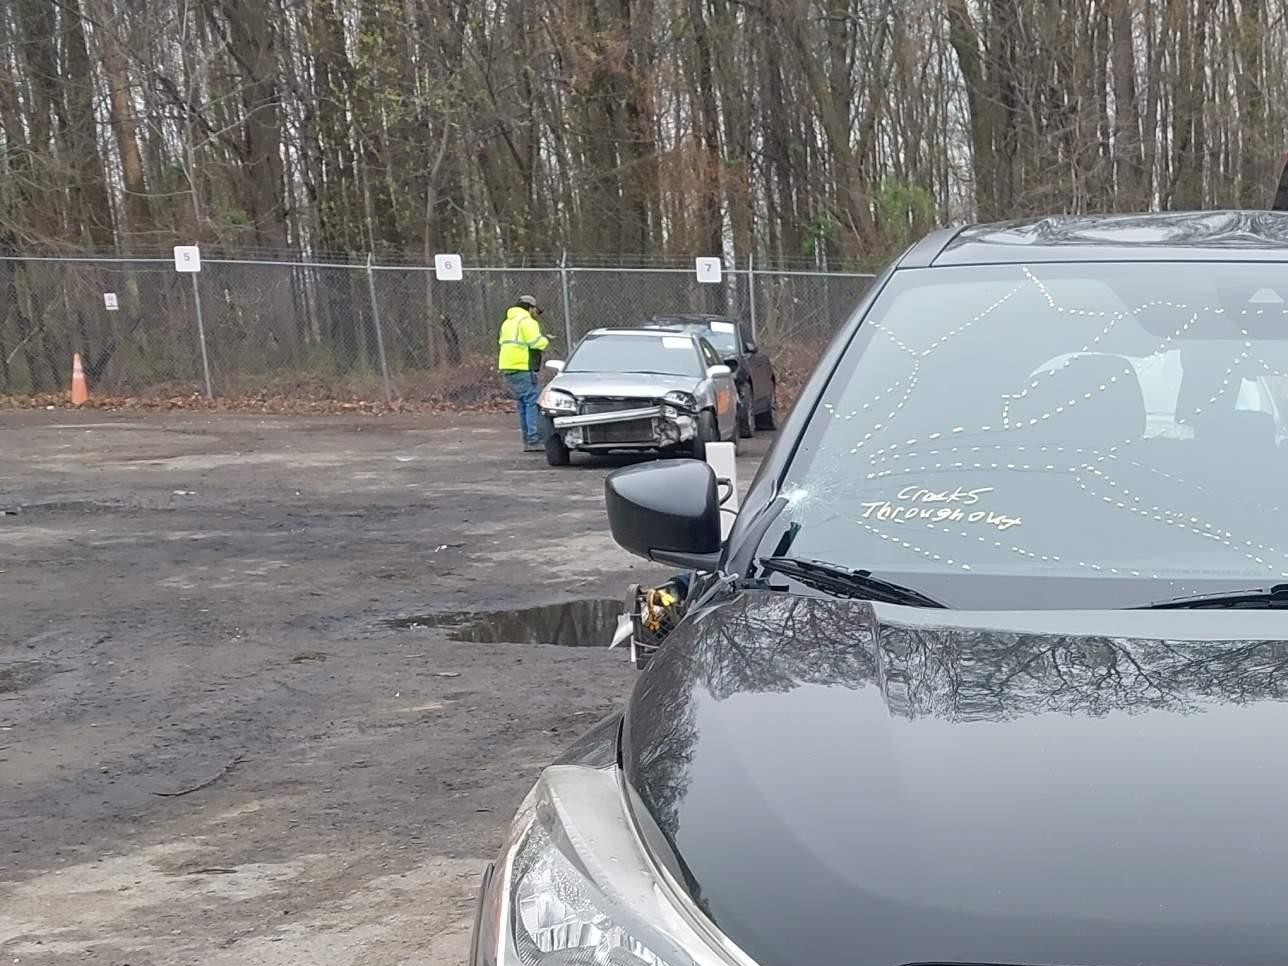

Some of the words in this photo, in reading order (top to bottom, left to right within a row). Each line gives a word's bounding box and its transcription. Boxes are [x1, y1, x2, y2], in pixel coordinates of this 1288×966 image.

[183, 252, 191, 262] 5
[444, 260, 453, 270] 6
[704, 263, 712, 273] 7
